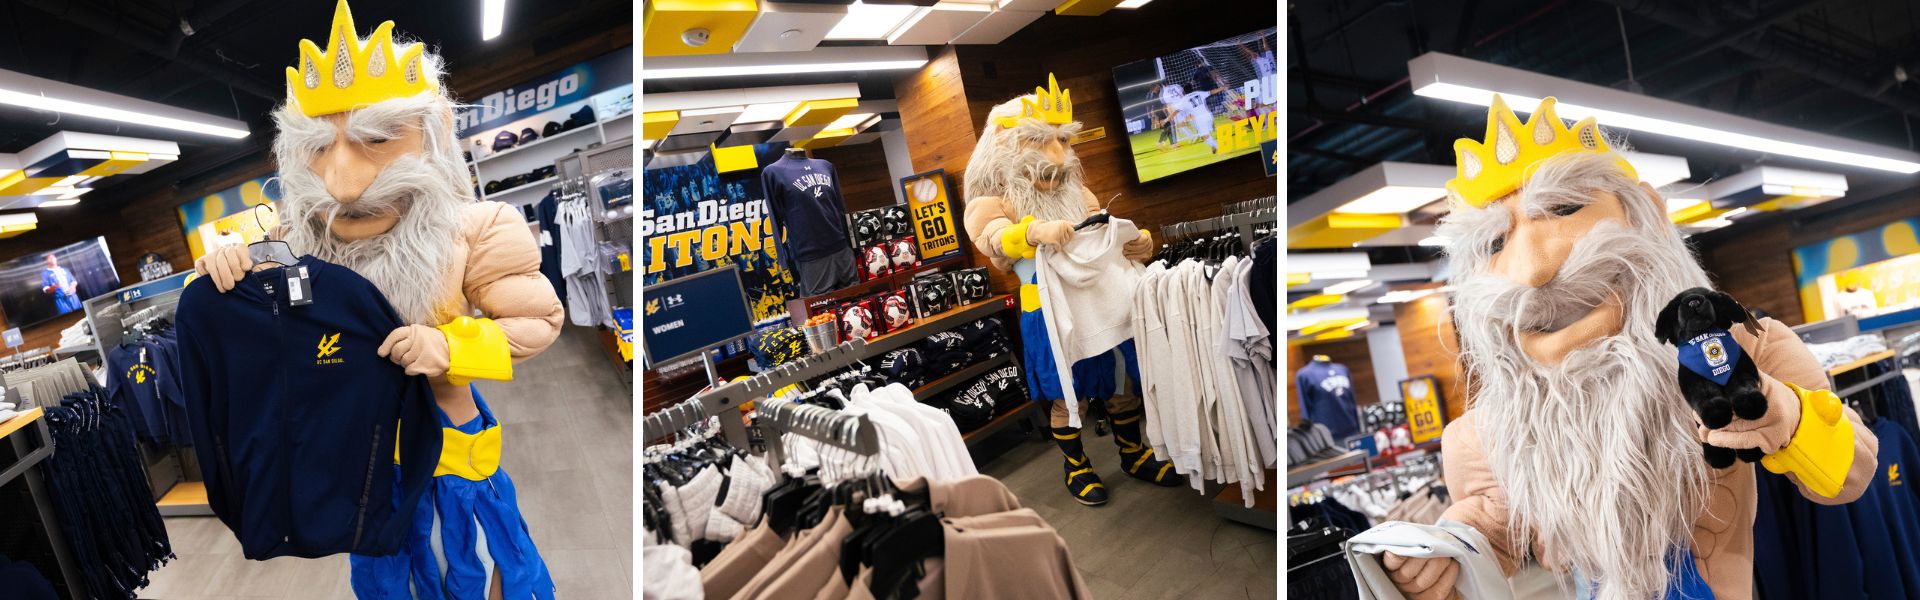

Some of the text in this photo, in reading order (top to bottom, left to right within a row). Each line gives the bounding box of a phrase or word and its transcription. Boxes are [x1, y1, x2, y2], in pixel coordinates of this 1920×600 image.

[792, 178, 807, 191] UC
[801, 173, 817, 187] SAN
[697, 199, 769, 227] Dieg
[914, 201, 946, 220] LET'S
[920, 216, 947, 240] GO
[643, 216, 787, 274] ITON
[922, 234, 956, 251] TRITONS
[652, 319, 685, 335] WOMEN
[984, 366, 1018, 384] SAN DIEGO
[1414, 411, 1434, 428] GO
